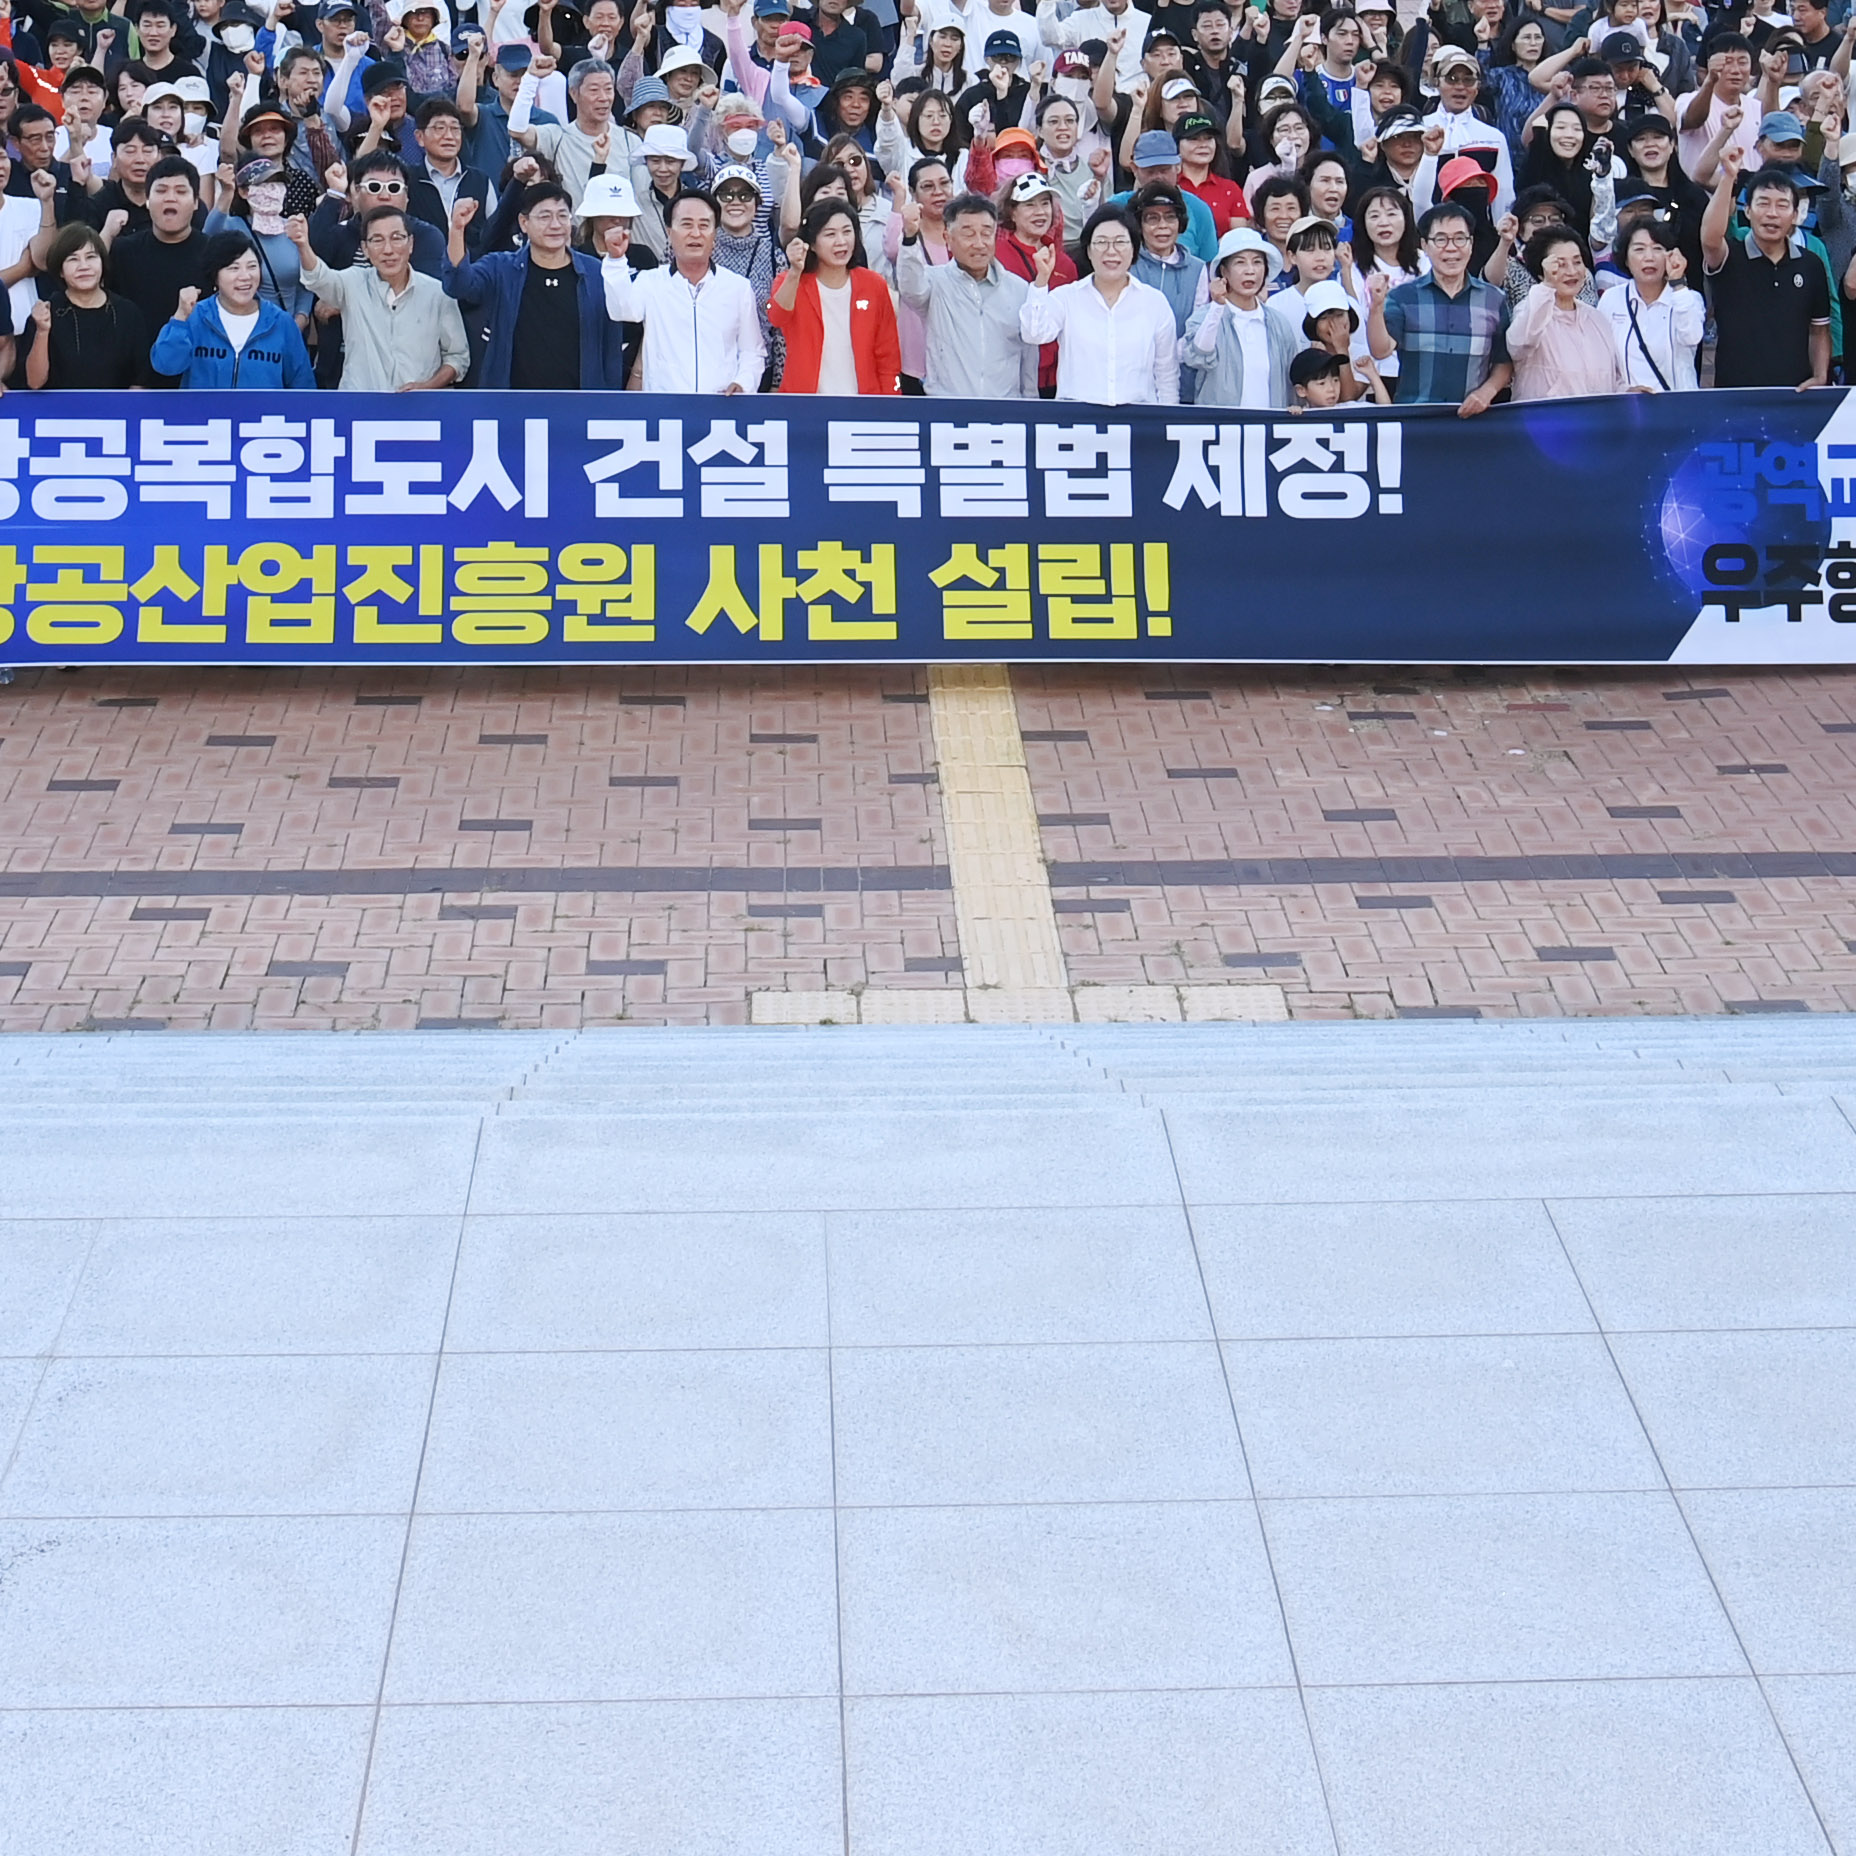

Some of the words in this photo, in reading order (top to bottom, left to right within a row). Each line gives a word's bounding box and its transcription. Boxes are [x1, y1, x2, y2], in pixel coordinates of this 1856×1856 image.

[583, 419, 790, 518] 건설
[823, 421, 1133, 518] 특별법
[1163, 421, 1403, 519] 제정!
[689, 541, 895, 640] 사천
[932, 543, 1170, 640] 설립!
